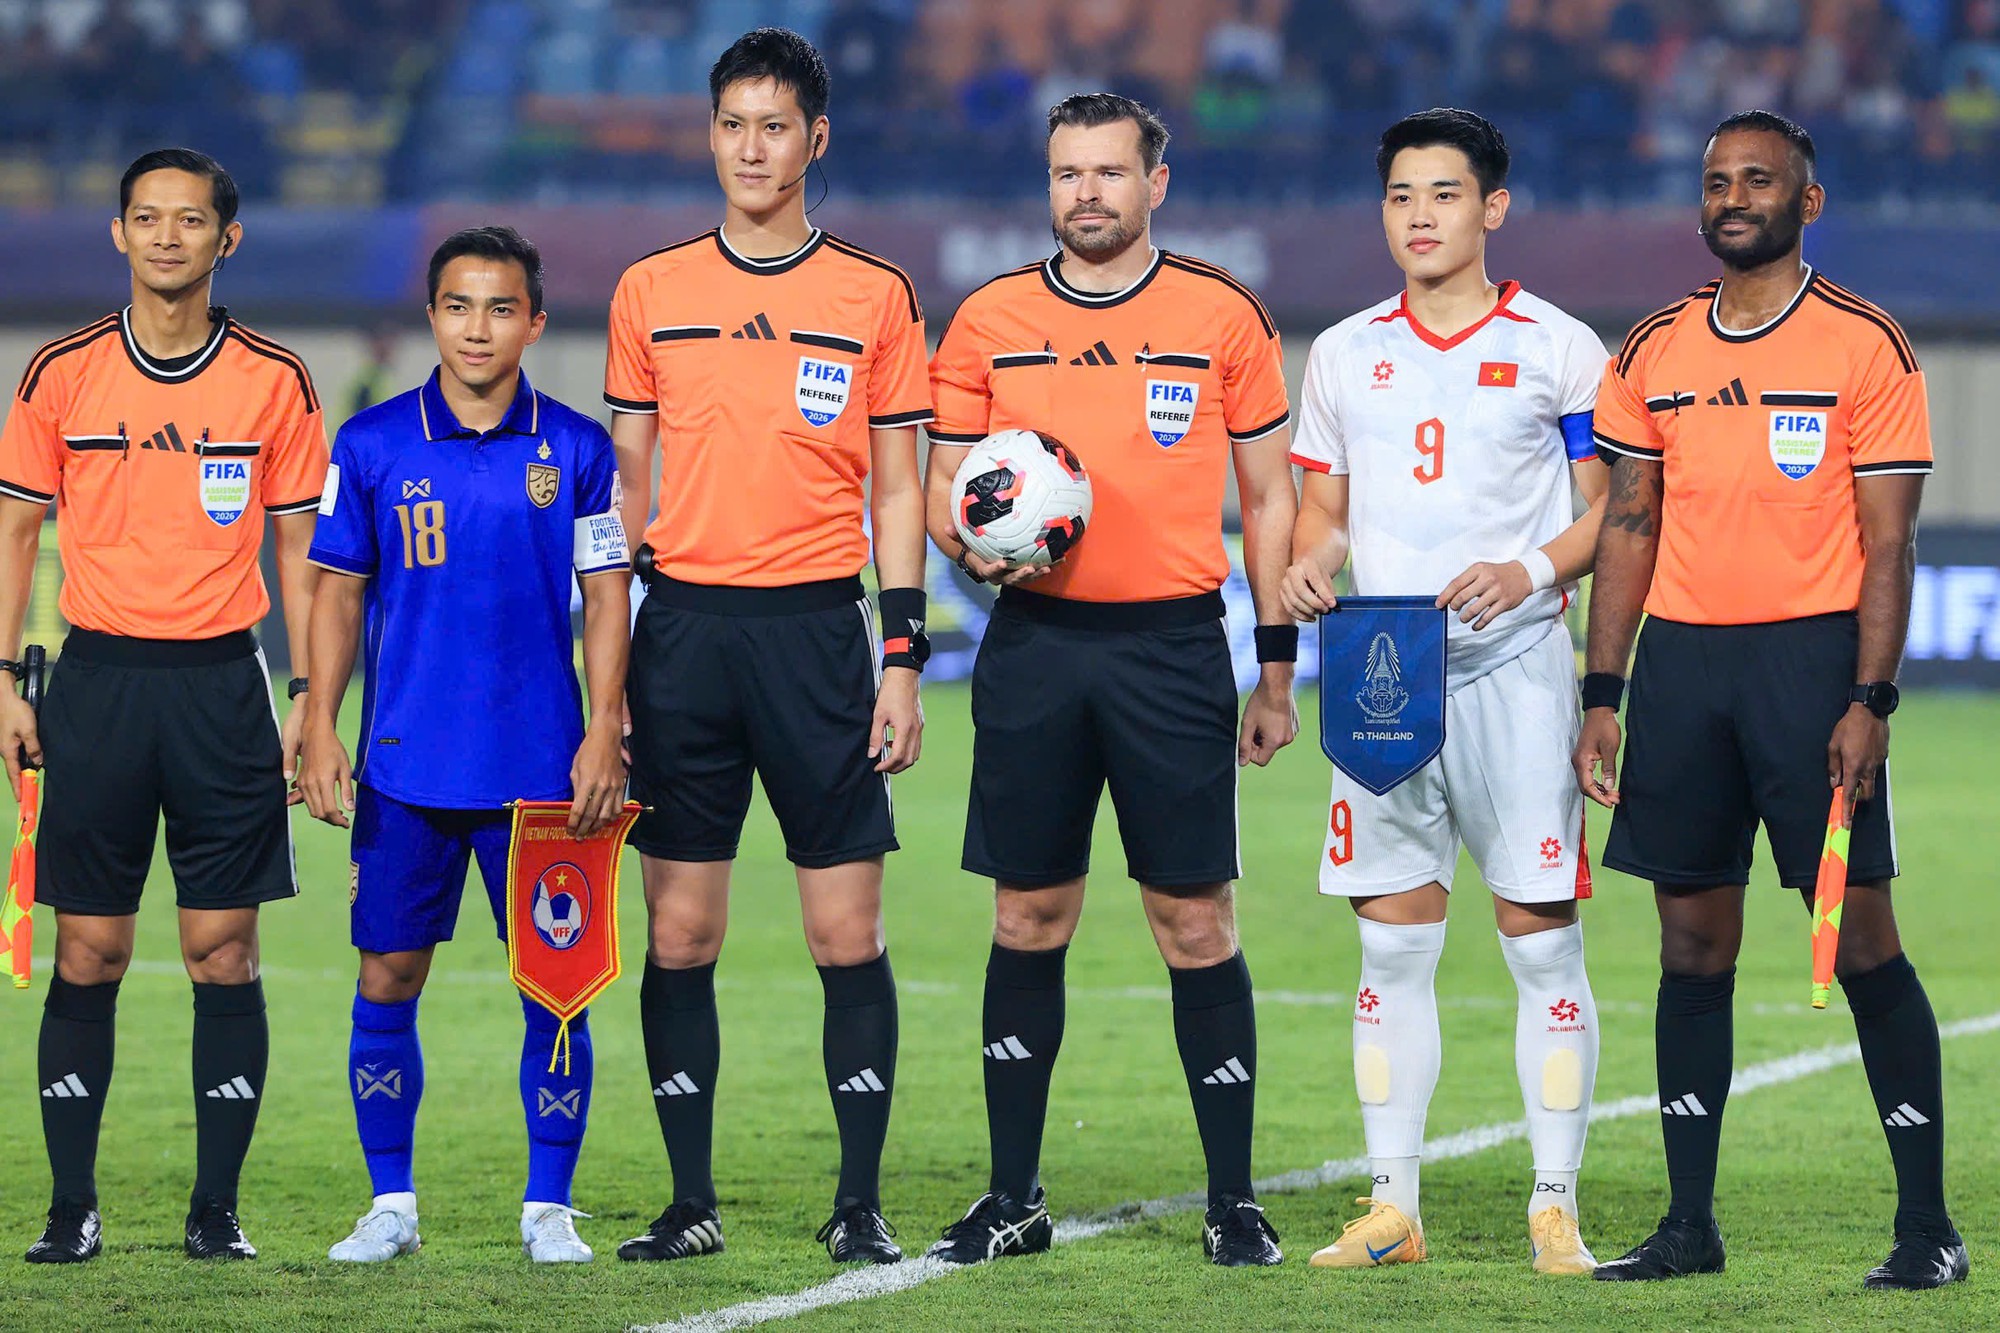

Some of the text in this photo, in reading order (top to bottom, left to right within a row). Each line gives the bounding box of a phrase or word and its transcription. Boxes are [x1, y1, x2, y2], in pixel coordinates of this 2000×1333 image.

[803, 361, 846, 384] FIFA
[799, 387, 844, 404] REFEREE
[1151, 384, 1193, 403] FIFA
[807, 411, 829, 422] 2026
[1150, 410, 1190, 422] REFEREE
[1775, 416, 1821, 432] FIFA
[1158, 434, 1177, 442] 2026
[1413, 417, 1445, 485] 9
[204, 463, 246, 479] FIFA
[1785, 465, 1807, 474] 2026
[214, 512, 235, 520] 2026
[393, 500, 446, 569] 18
[1352, 731, 1414, 740] FA THAILAND
[1329, 799, 1353, 867] 9
[552, 927, 570, 938] VFF
